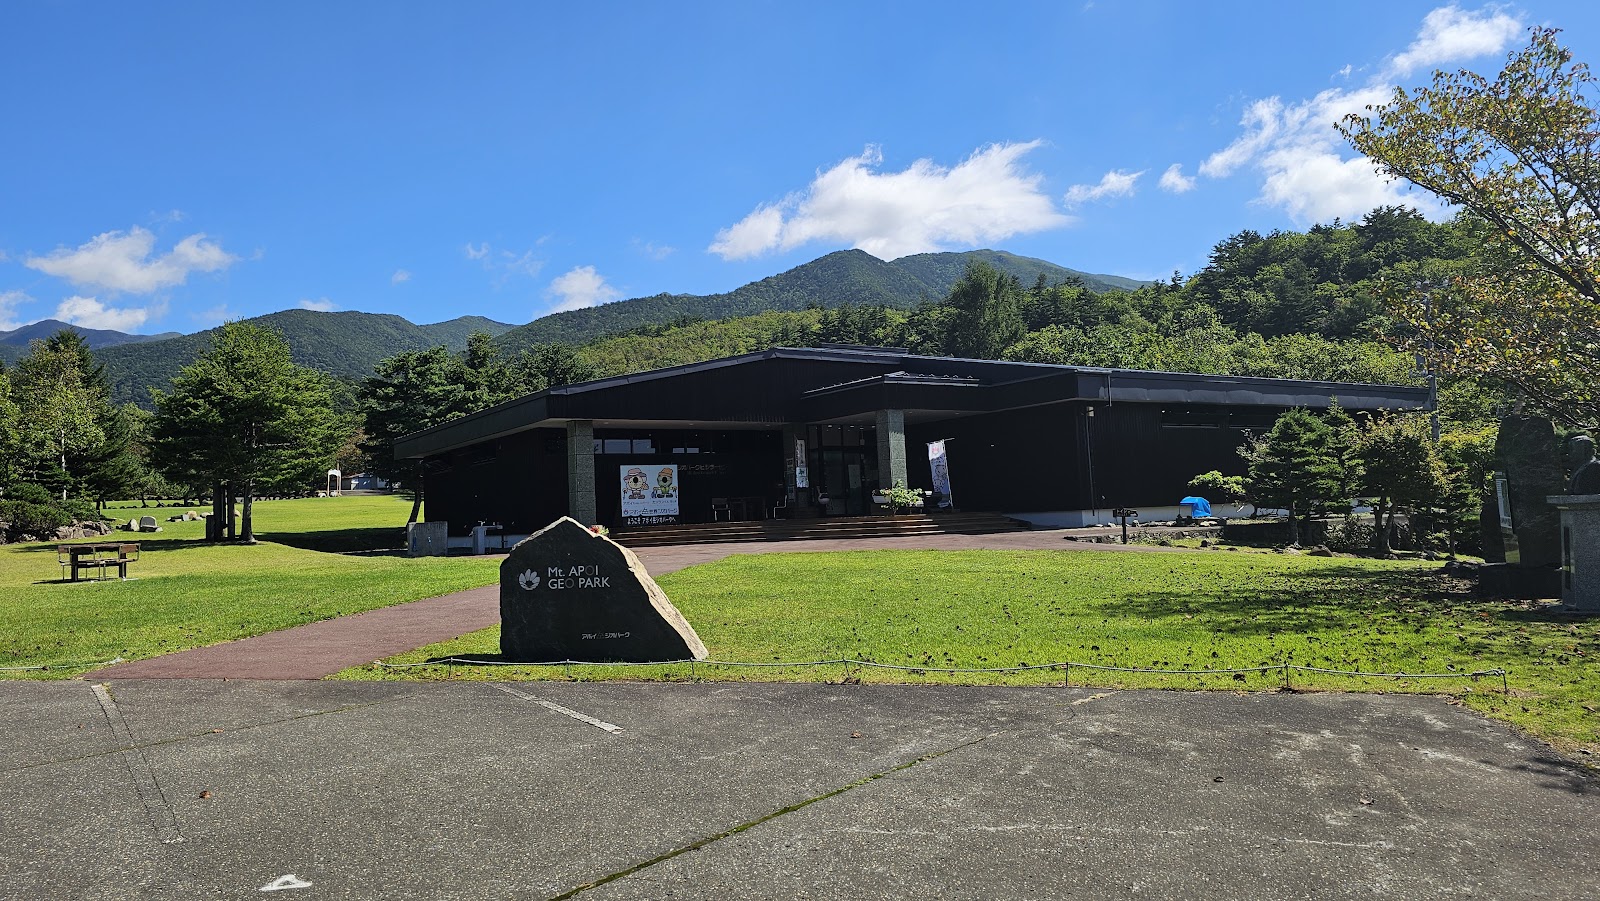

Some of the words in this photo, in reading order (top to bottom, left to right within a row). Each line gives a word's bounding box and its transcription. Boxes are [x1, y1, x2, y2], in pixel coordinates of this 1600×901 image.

[548, 566, 566, 577] Mt.
[569, 564, 599, 577] APOI
[548, 577, 575, 590] GEO
[578, 576, 611, 589] PARK
